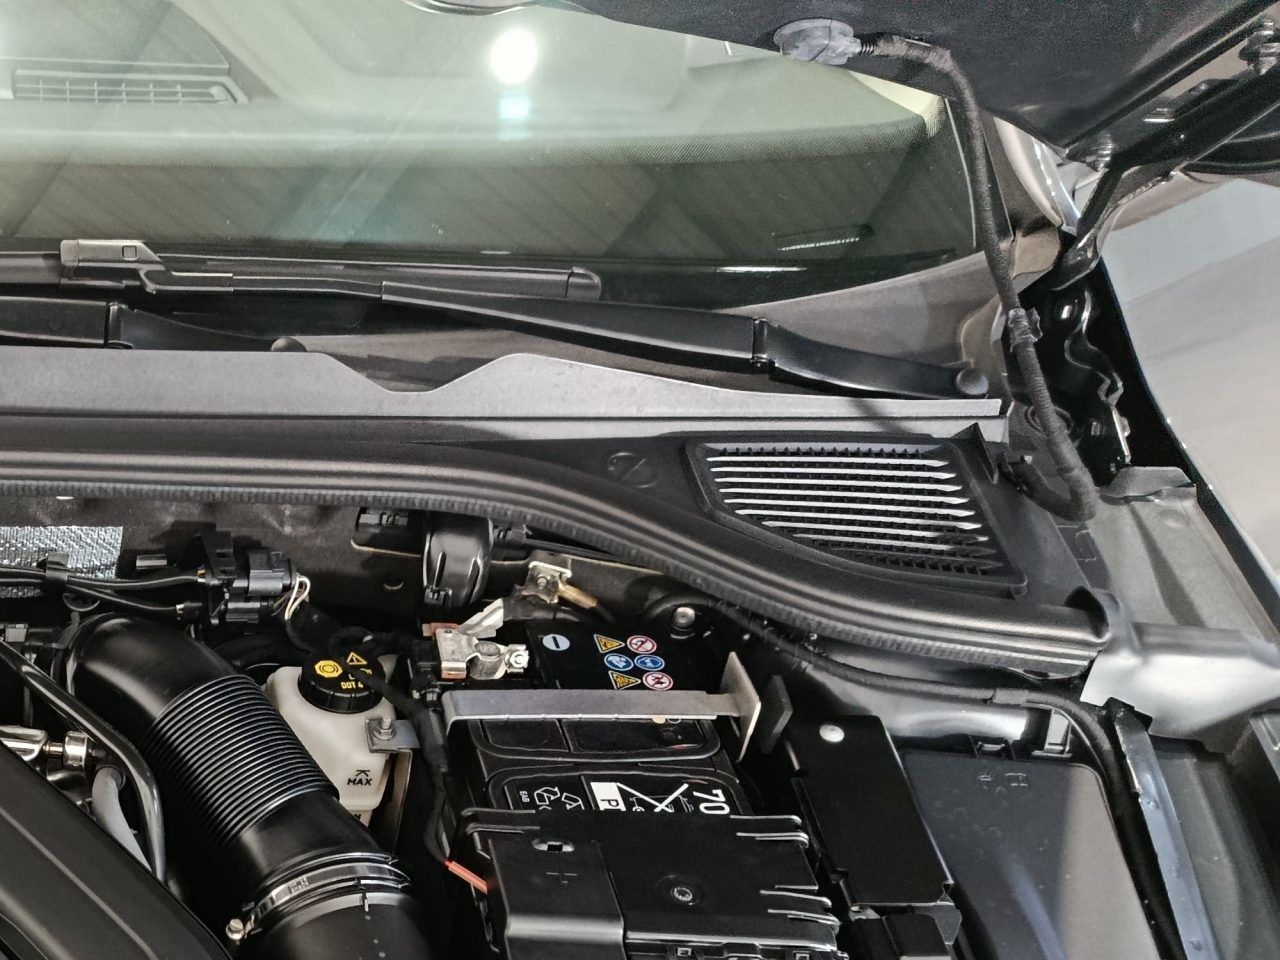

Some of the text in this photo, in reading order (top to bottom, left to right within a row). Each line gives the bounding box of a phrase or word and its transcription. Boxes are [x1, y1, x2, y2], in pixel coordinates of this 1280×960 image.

[341, 681, 356, 690] DOT
[347, 778, 373, 786] MAX
[692, 788, 730, 815] 70
